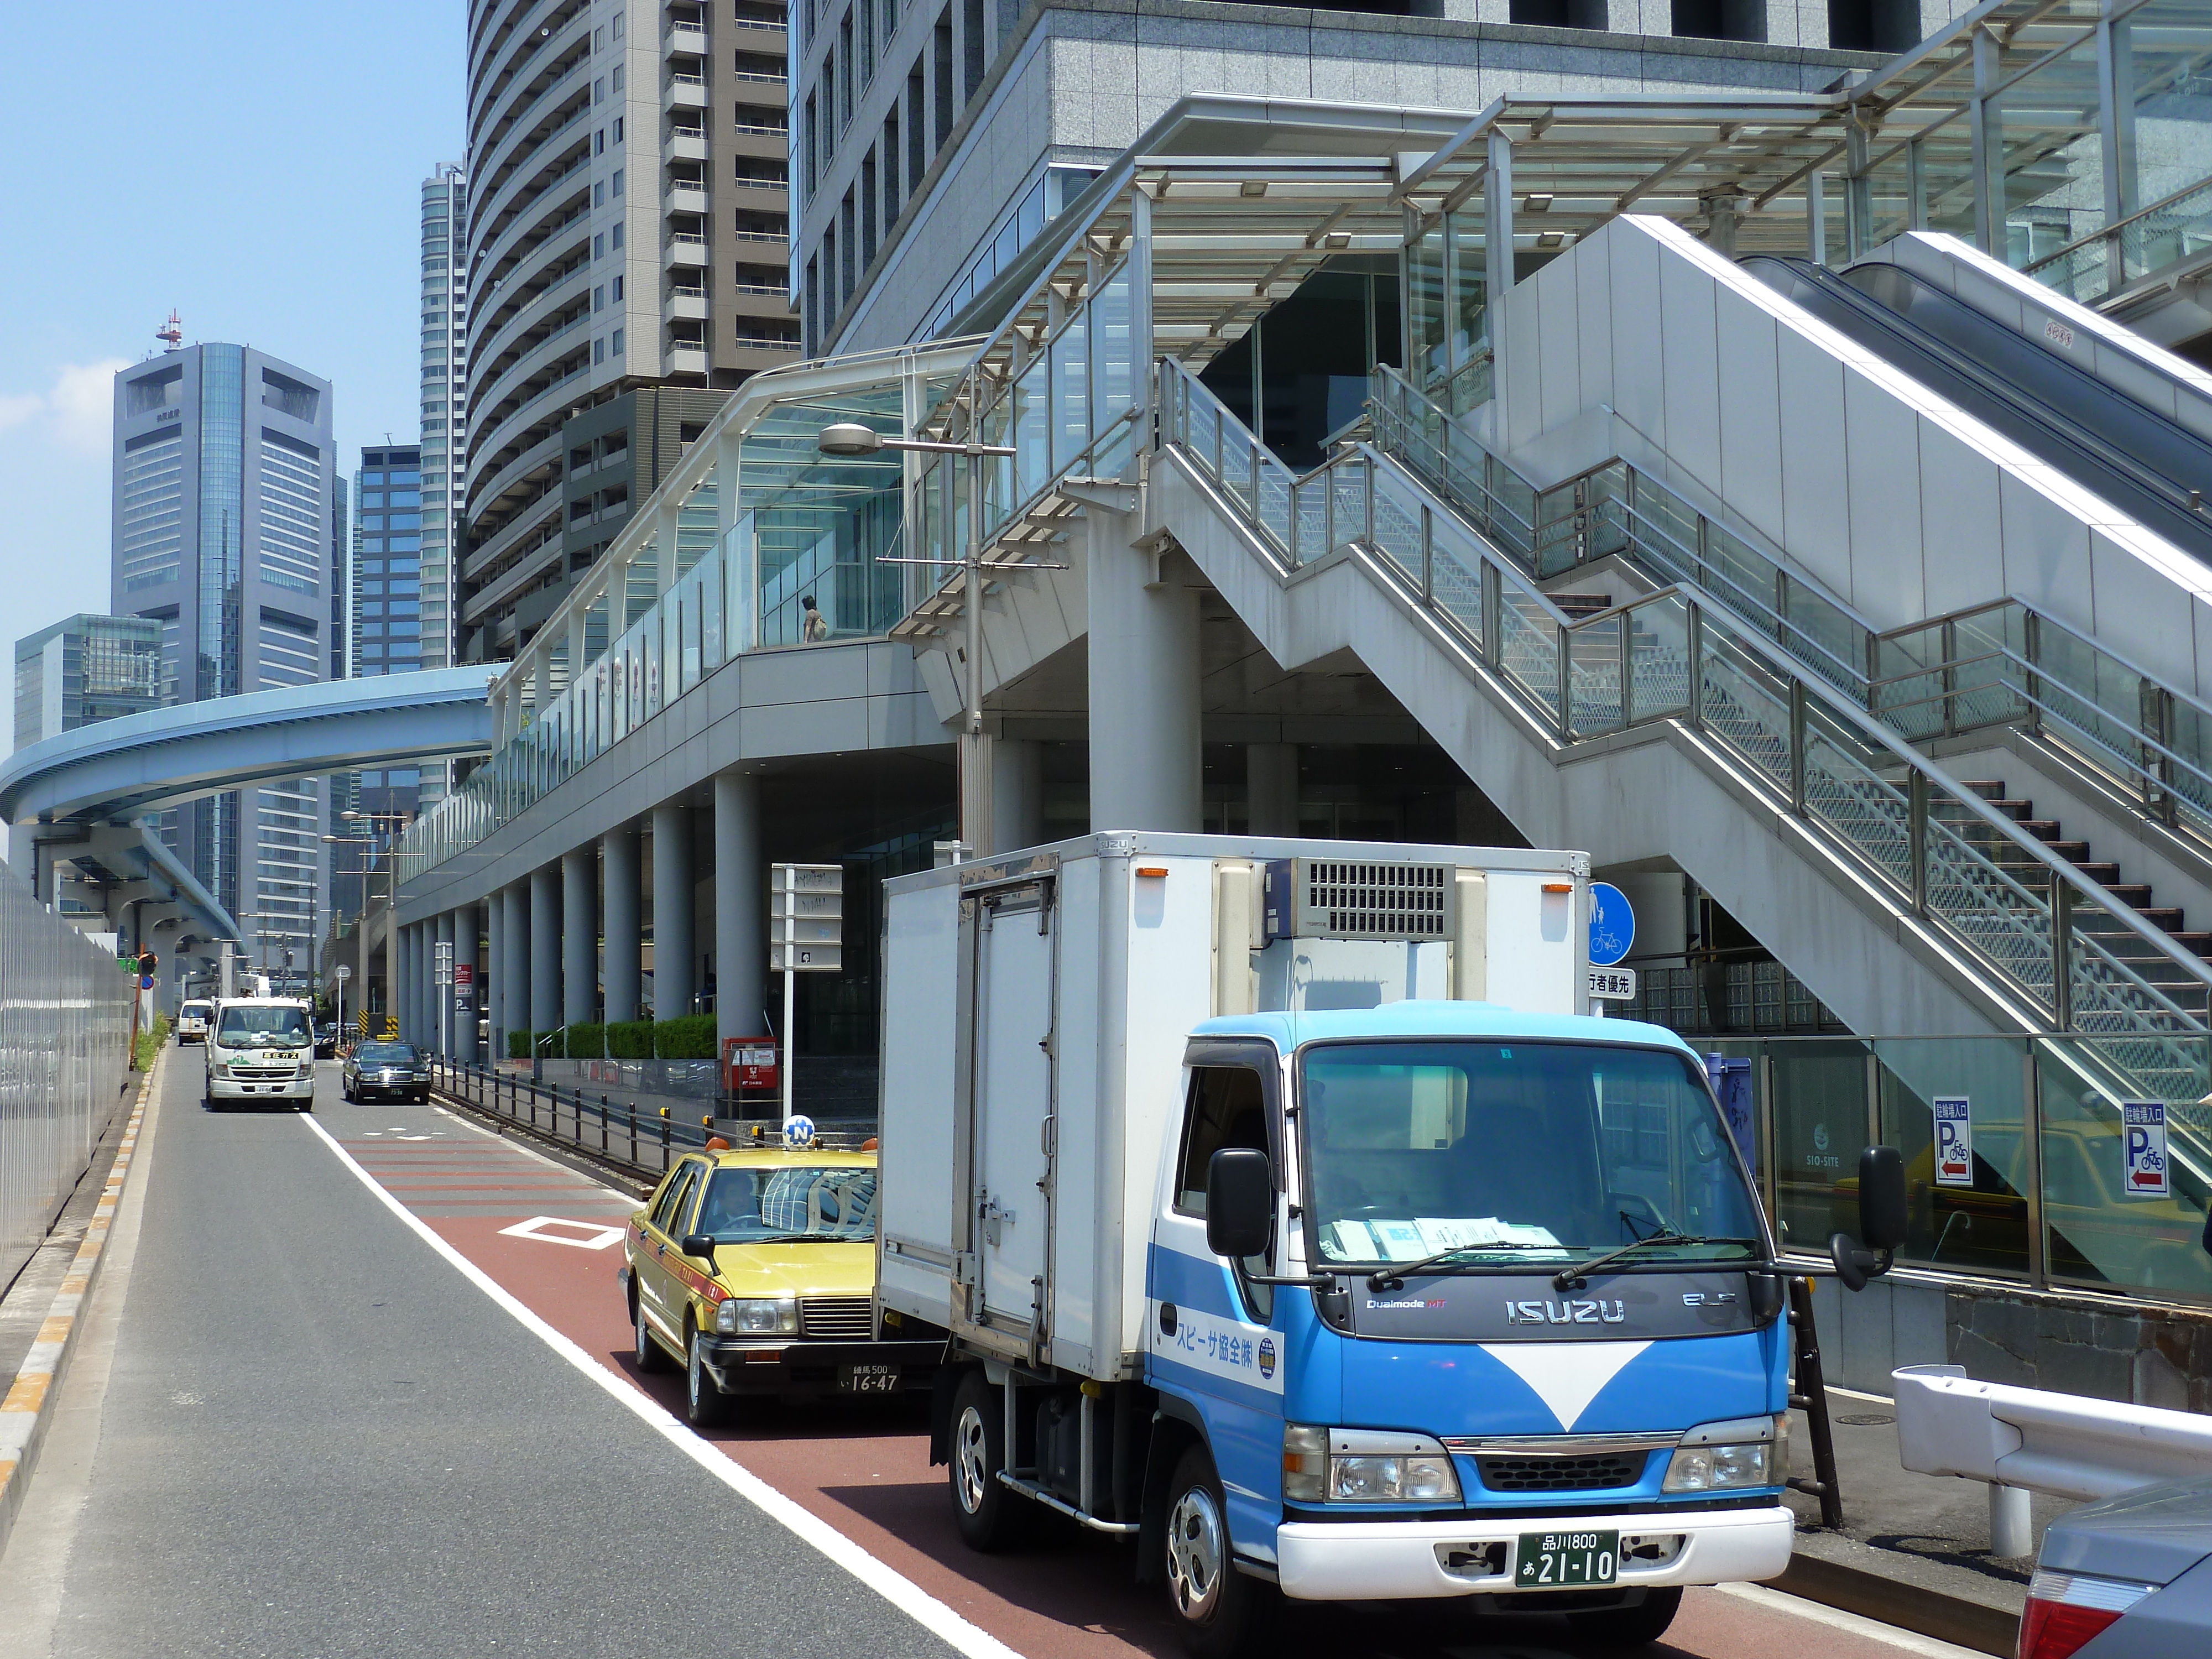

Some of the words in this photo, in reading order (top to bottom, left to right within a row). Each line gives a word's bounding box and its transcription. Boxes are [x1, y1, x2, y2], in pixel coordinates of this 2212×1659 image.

[1100, 841, 1127, 849] SUZU
[1936, 1103, 1966, 1119] 駐輪場入口
[2125, 1107, 2162, 1123] 駐輪場入口
[794, 1126, 808, 1139] N
[1938, 1121, 1955, 1158] P
[2127, 1126, 2148, 1167] P
[1807, 1155, 1839, 1167] SIO-SITE
[1366, 1299, 1425, 1308] Dualmode
[1427, 1299, 1447, 1308] MT
[1682, 1292, 1736, 1307] ELF
[1506, 1300, 1625, 1325] ISUZU
[853, 1375, 897, 1391] 16-47
[1522, 1561, 1535, 1576] あ
[1538, 1551, 1613, 1583] 21-10
